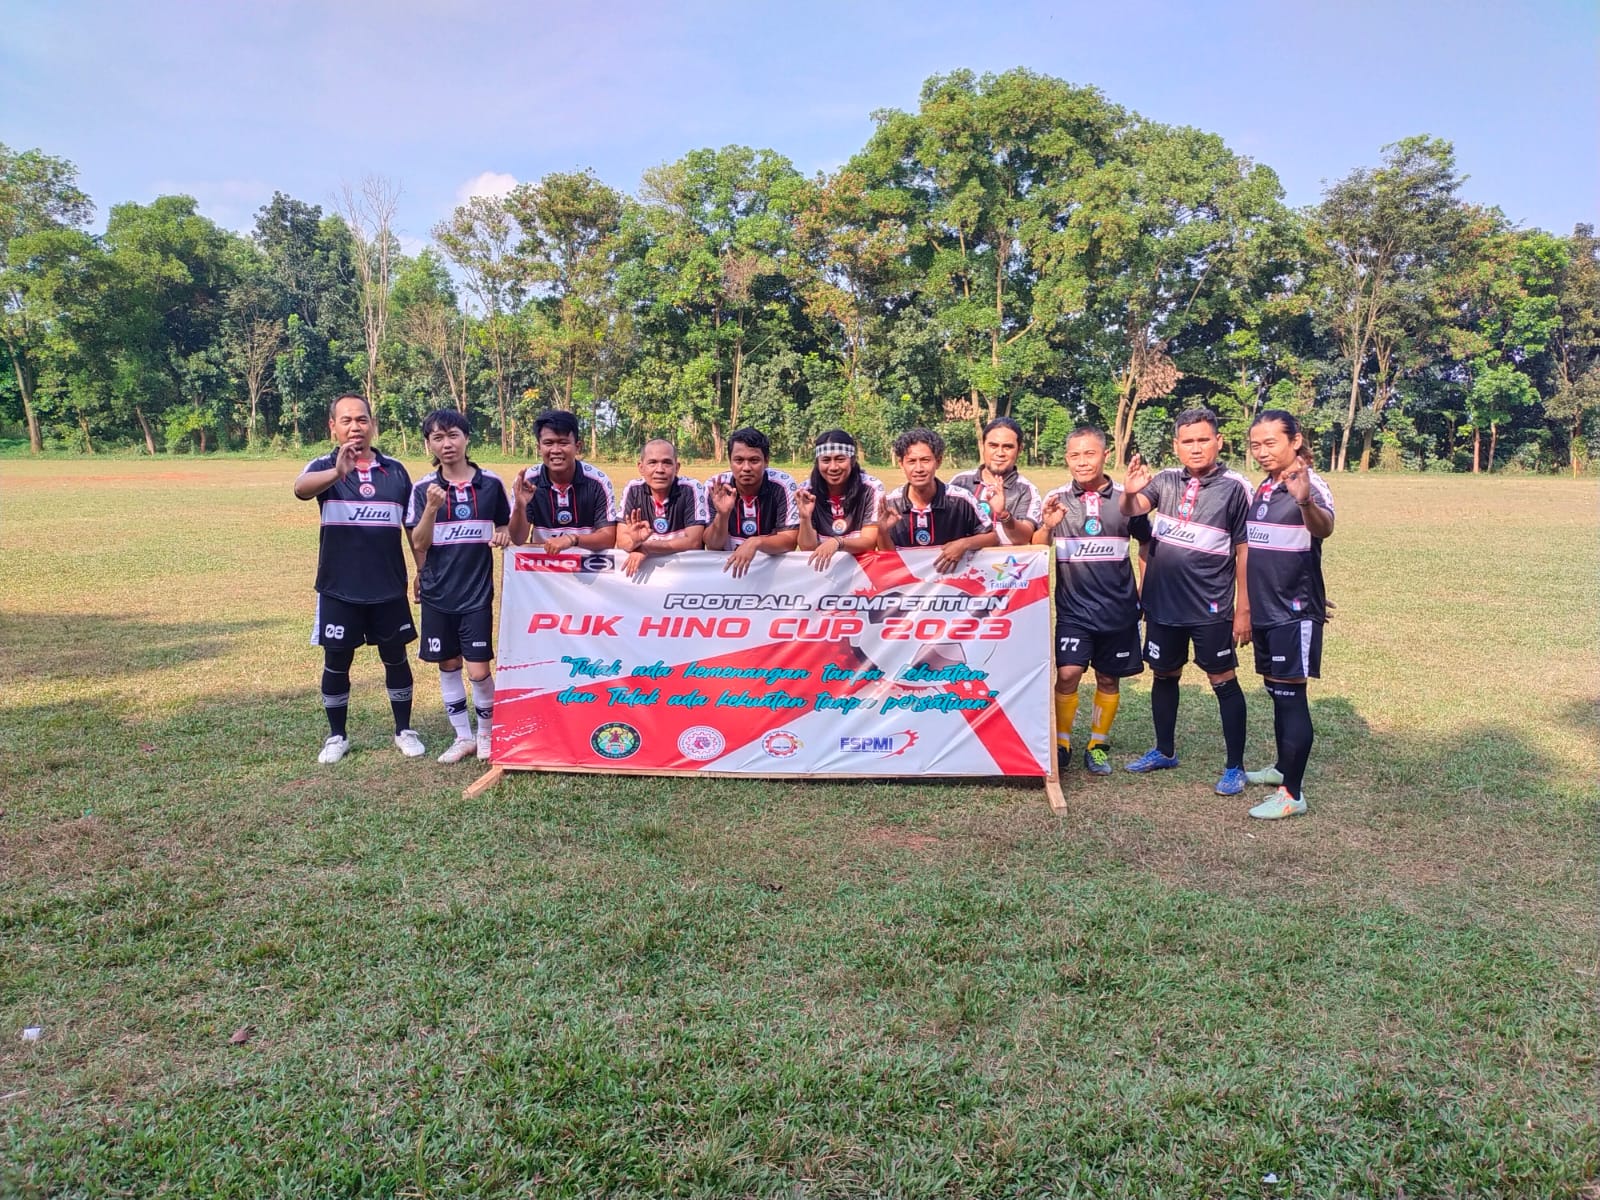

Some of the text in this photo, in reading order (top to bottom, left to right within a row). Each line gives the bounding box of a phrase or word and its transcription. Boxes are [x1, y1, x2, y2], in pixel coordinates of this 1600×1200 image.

[348, 505, 391, 521] Hino
[445, 525, 483, 540] Hino
[1075, 541, 1115, 556] Hino
[519, 558, 577, 569] HINO
[664, 593, 1010, 612] FOOTBALL COMPETITION
[325, 624, 345, 639] 08
[527, 613, 1013, 642] PUK HINO CUP 2023
[427, 637, 441, 652] 10
[1060, 637, 1080, 652] 77
[631, 660, 674, 680] ada
[683, 661, 811, 685] kemenangan
[821, 663, 885, 686] tanpa
[894, 663, 989, 683] kekuatan
[557, 686, 599, 706] dan
[606, 687, 660, 708] Tidak
[667, 689, 710, 709] ada
[715, 690, 807, 712] kekuatan
[814, 691, 878, 715] tanpa
[840, 737, 893, 750] FSPMI
